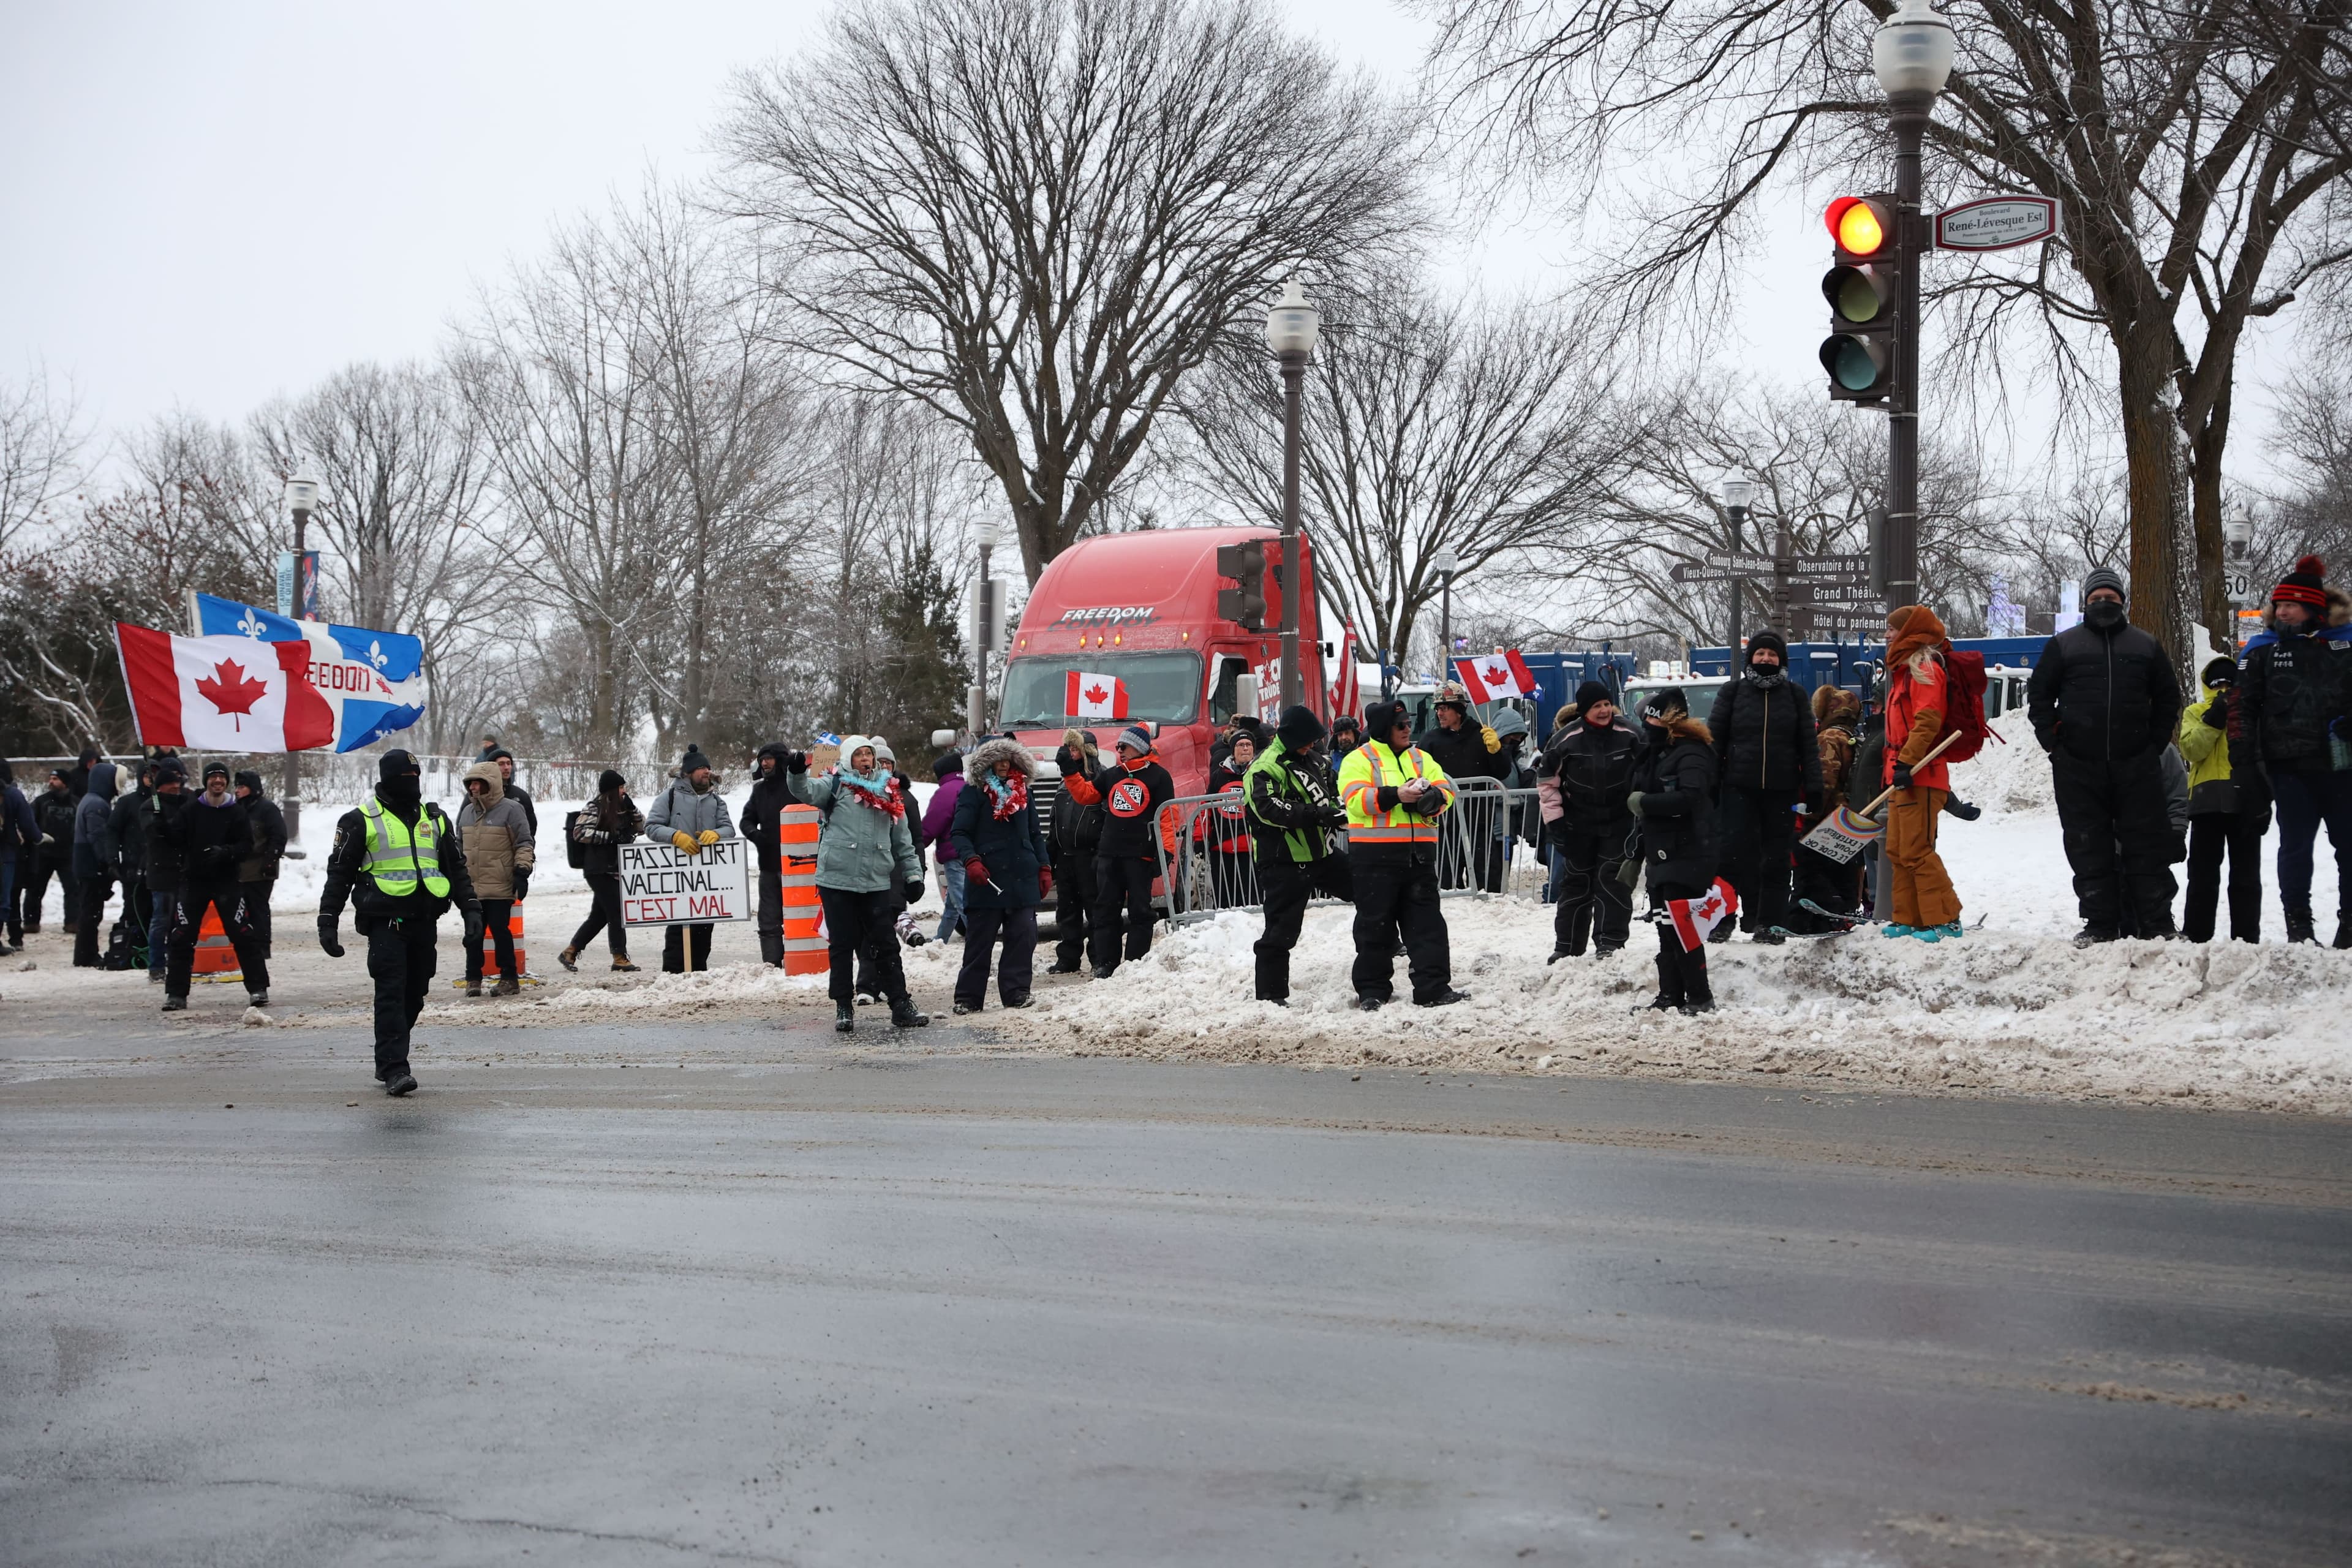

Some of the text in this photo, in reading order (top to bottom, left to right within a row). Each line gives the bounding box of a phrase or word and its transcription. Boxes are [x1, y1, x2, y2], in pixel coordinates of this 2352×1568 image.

[1979, 207, 2010, 216] Boulevard
[1948, 212, 2043, 233] René-Lévesque Est
[1709, 552, 1774, 574] Faubourg Saint-Jean-Baptiste
[1796, 559, 1842, 573] Observatoire
[1845, 558, 1855, 571] de
[1858, 558, 1865, 571] la
[1813, 587, 1841, 600] Grand
[2225, 576, 2247, 595] 50
[1061, 606, 1155, 622] FREEDOM
[1047, 616, 1162, 631] CONVOY
[1813, 614, 1887, 631] Hôtel du parlement
[307, 661, 370, 692] EEDOM
[1259, 682, 1281, 701] TRUDE
[1264, 780, 1275, 796] TEA
[47, 805, 75, 815] FXR
[385, 818, 396, 844] POLICE
[1818, 845, 1839, 857] CODE
[1833, 842, 1856, 856] POUR
[1837, 854, 1849, 863] LE
[621, 870, 734, 896] VACCINAL...
[624, 895, 732, 922] C'EST MAL
